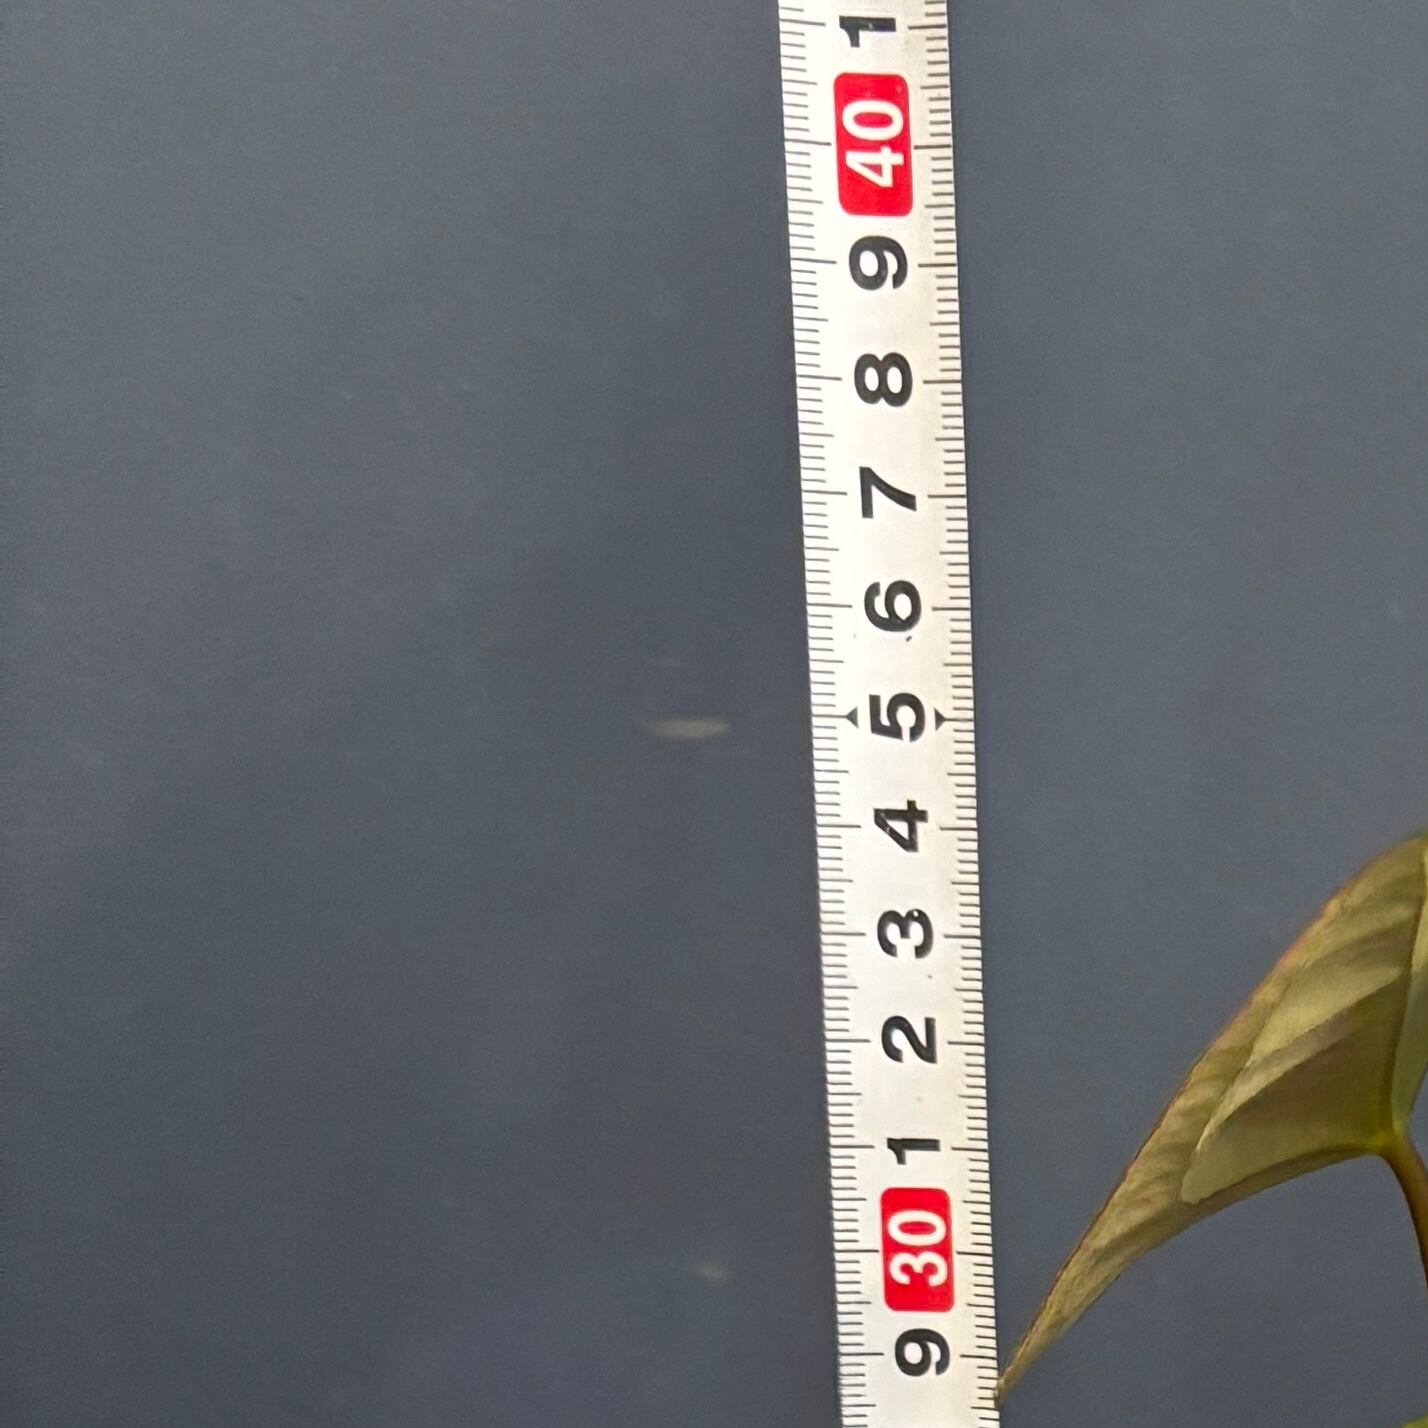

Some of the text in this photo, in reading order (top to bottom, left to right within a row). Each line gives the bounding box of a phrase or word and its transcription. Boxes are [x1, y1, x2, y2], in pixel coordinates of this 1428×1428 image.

[839, 16, 896, 48] 1
[842, 99, 904, 188] 40
[849, 235, 908, 291] 9
[854, 352, 913, 407] 8
[859, 466, 917, 519] 7
[864, 580, 922, 633] 6
[869, 692, 925, 743] 5
[874, 798, 928, 852] 4
[877, 908, 934, 959] 3
[881, 1015, 937, 1064] 2
[887, 1137, 941, 1165] 1
[888, 1210, 948, 1288] 30
[895, 1328, 950, 1377] 9
